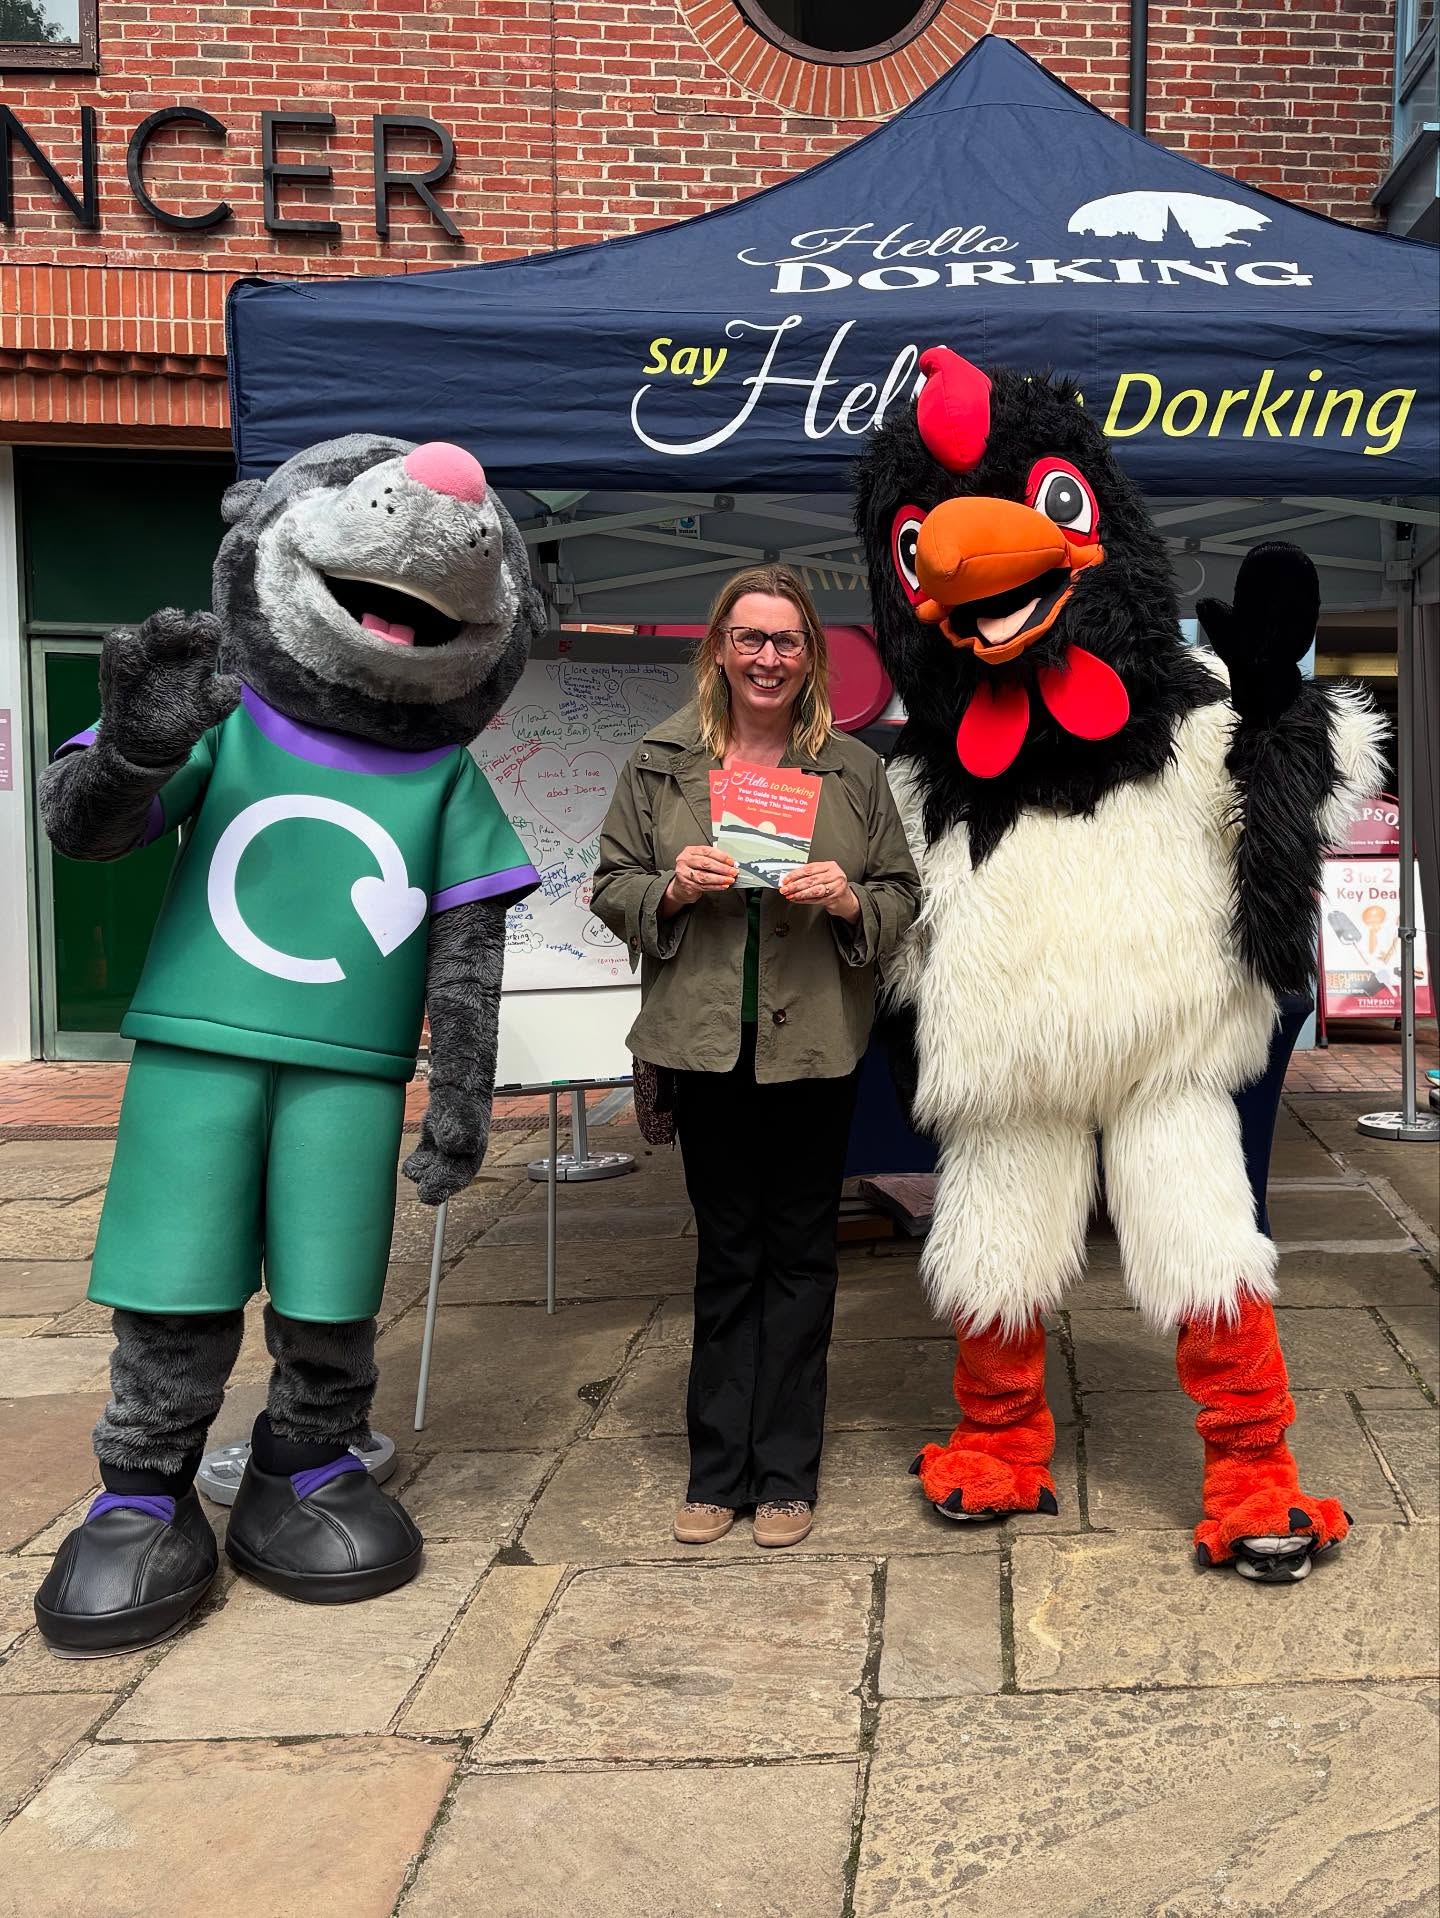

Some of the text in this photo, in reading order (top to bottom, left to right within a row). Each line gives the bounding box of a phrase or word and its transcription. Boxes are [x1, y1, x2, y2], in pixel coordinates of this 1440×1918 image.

[0, 104, 464, 241] NCER
[737, 221, 1020, 267] Hello
[768, 256, 1314, 295] DORKING
[629, 312, 1417, 458] Say Hel Dorking
[565, 724, 589, 737] Bank
[537, 769, 600, 779] What I love
[731, 770, 769, 786] Hello
[770, 782, 779, 791] to
[780, 783, 815, 799] Dorking
[753, 789, 771, 800] Guide
[745, 796, 768, 808] Dorking
[769, 801, 782, 809] This
[782, 804, 807, 814] Summer
[1342, 867, 1354, 884] 3
[1382, 867, 1394, 884] 2
[1336, 887, 1364, 903] Key
